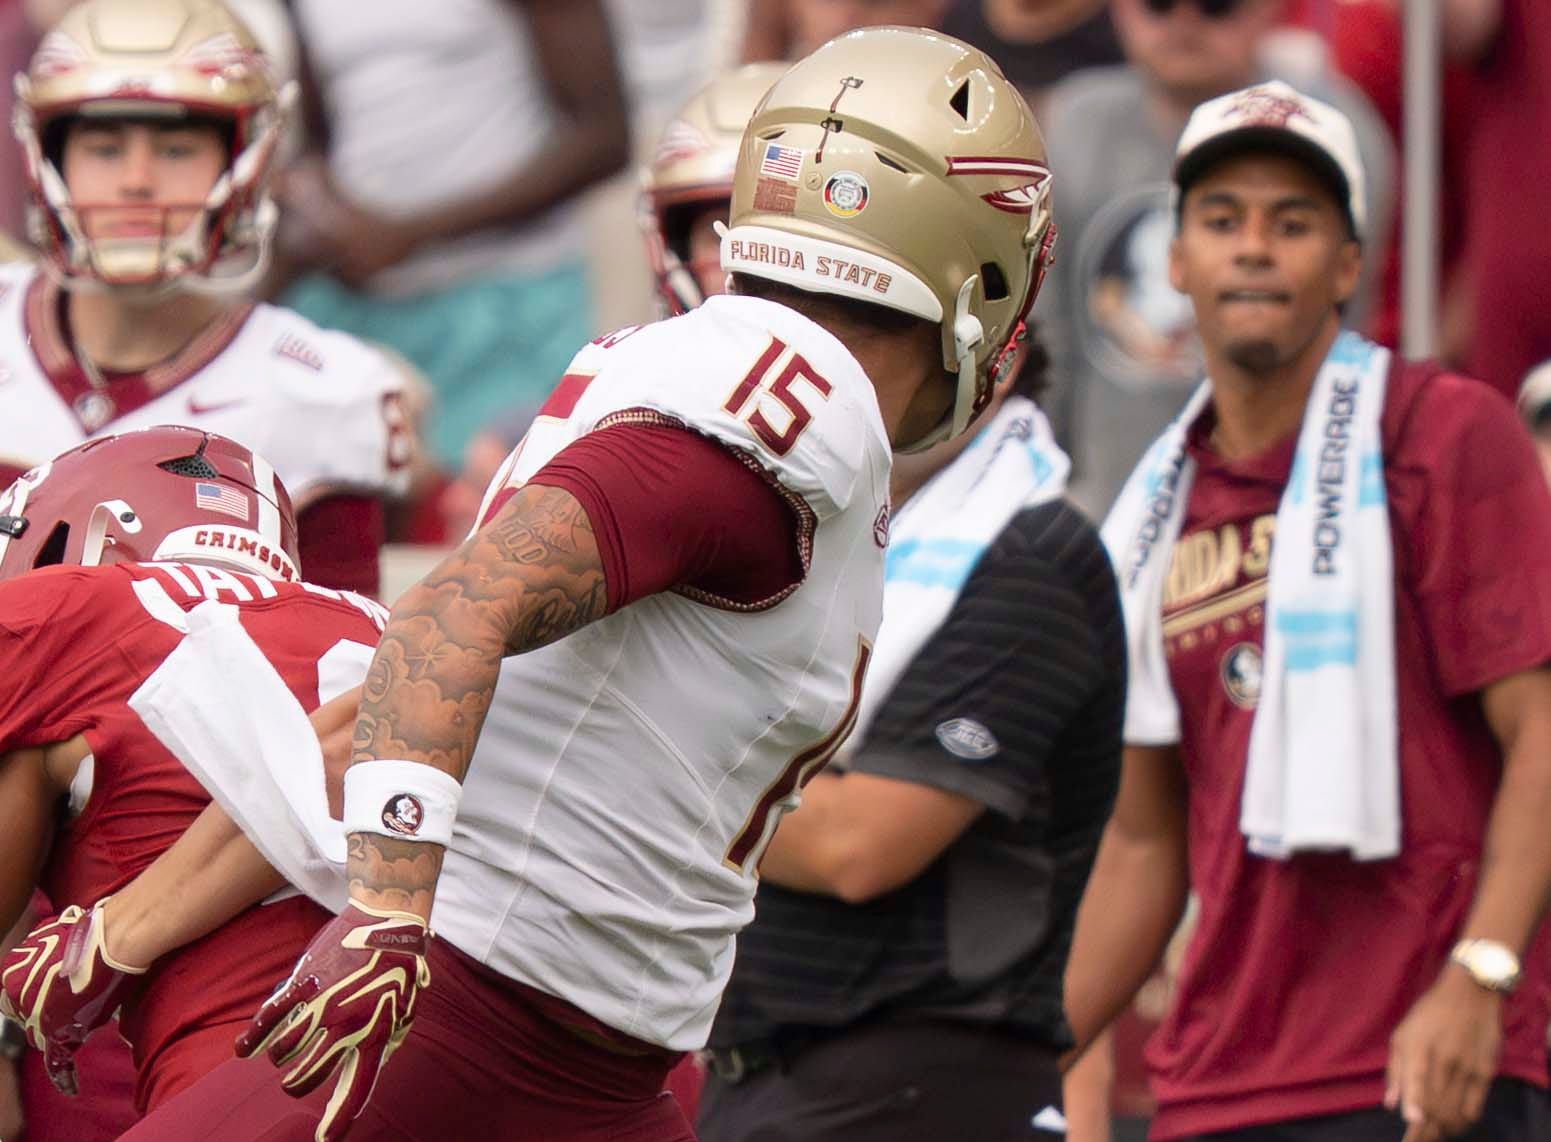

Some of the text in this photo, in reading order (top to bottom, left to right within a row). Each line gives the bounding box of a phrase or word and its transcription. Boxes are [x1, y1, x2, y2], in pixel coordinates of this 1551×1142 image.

[730, 240, 893, 293] FLORIDA STATE
[723, 331, 833, 459] 15
[1312, 377, 1359, 577] POWERADE
[194, 529, 294, 582] CRIMSON
